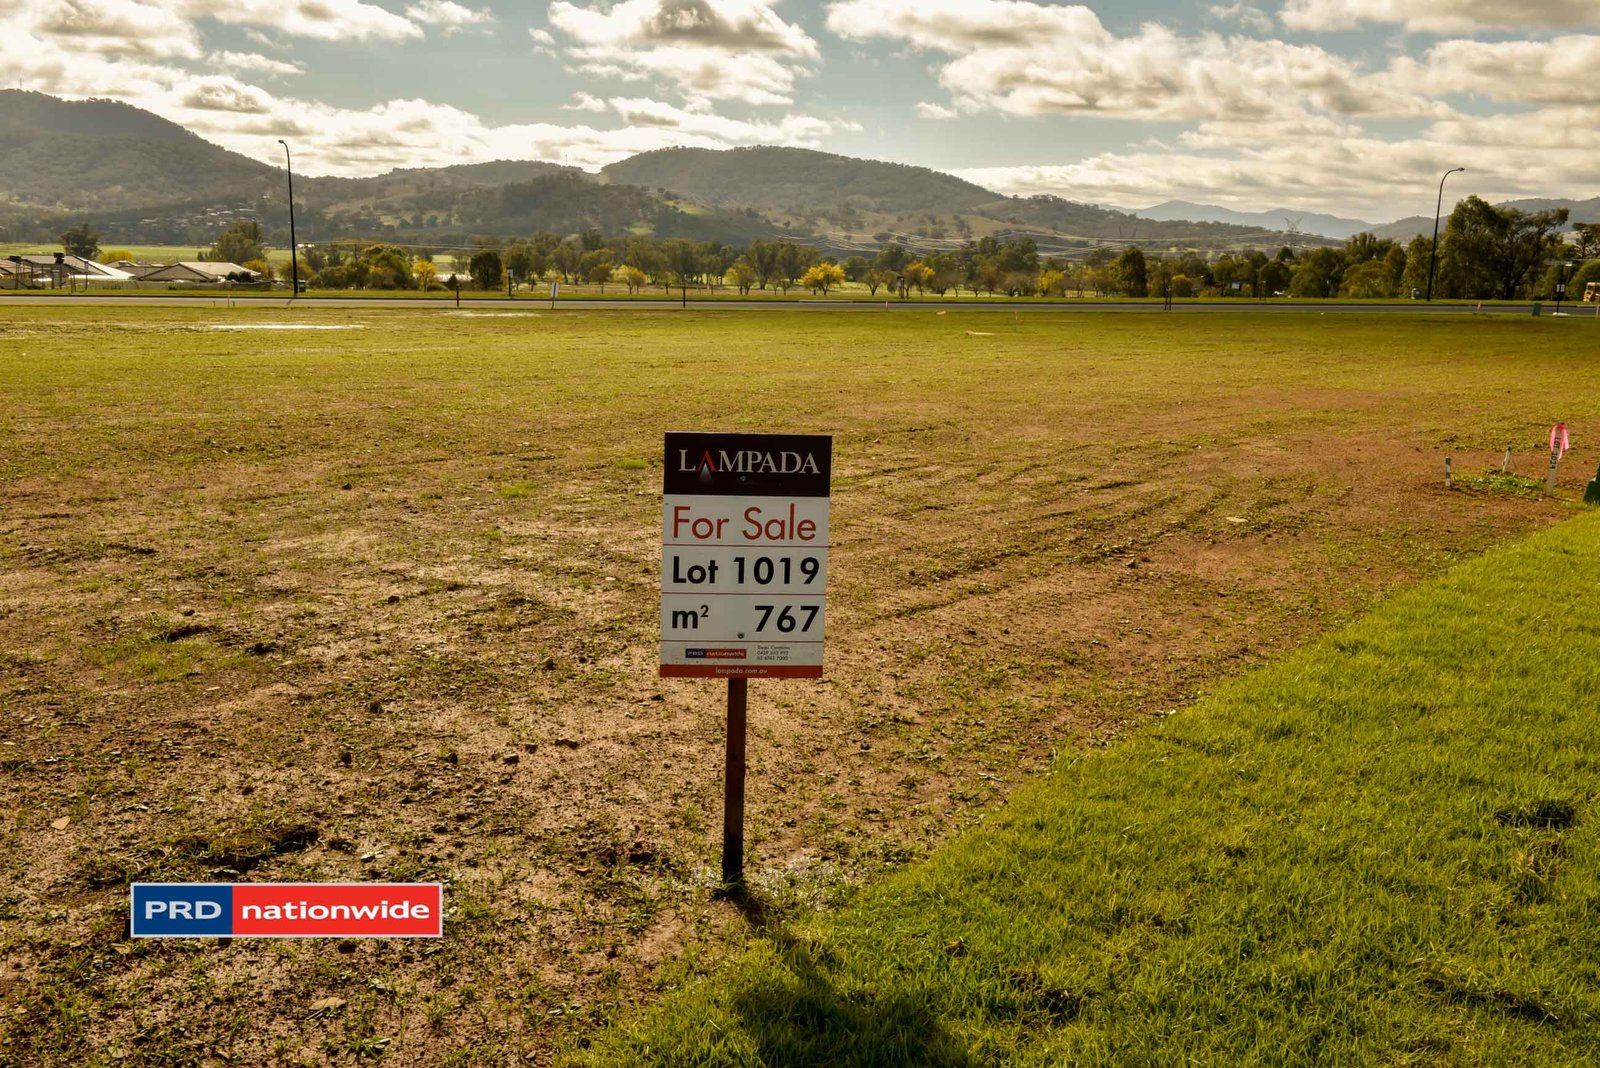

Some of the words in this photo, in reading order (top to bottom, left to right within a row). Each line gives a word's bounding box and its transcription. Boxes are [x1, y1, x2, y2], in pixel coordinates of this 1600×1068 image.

[678, 449, 821, 475] LAMPADA
[673, 505, 730, 540] For
[742, 503, 817, 541] Sale
[672, 555, 719, 585] Lot
[733, 556, 820, 585] 1019
[754, 605, 820, 633] 767
[715, 666, 768, 675] lampada.com.au
